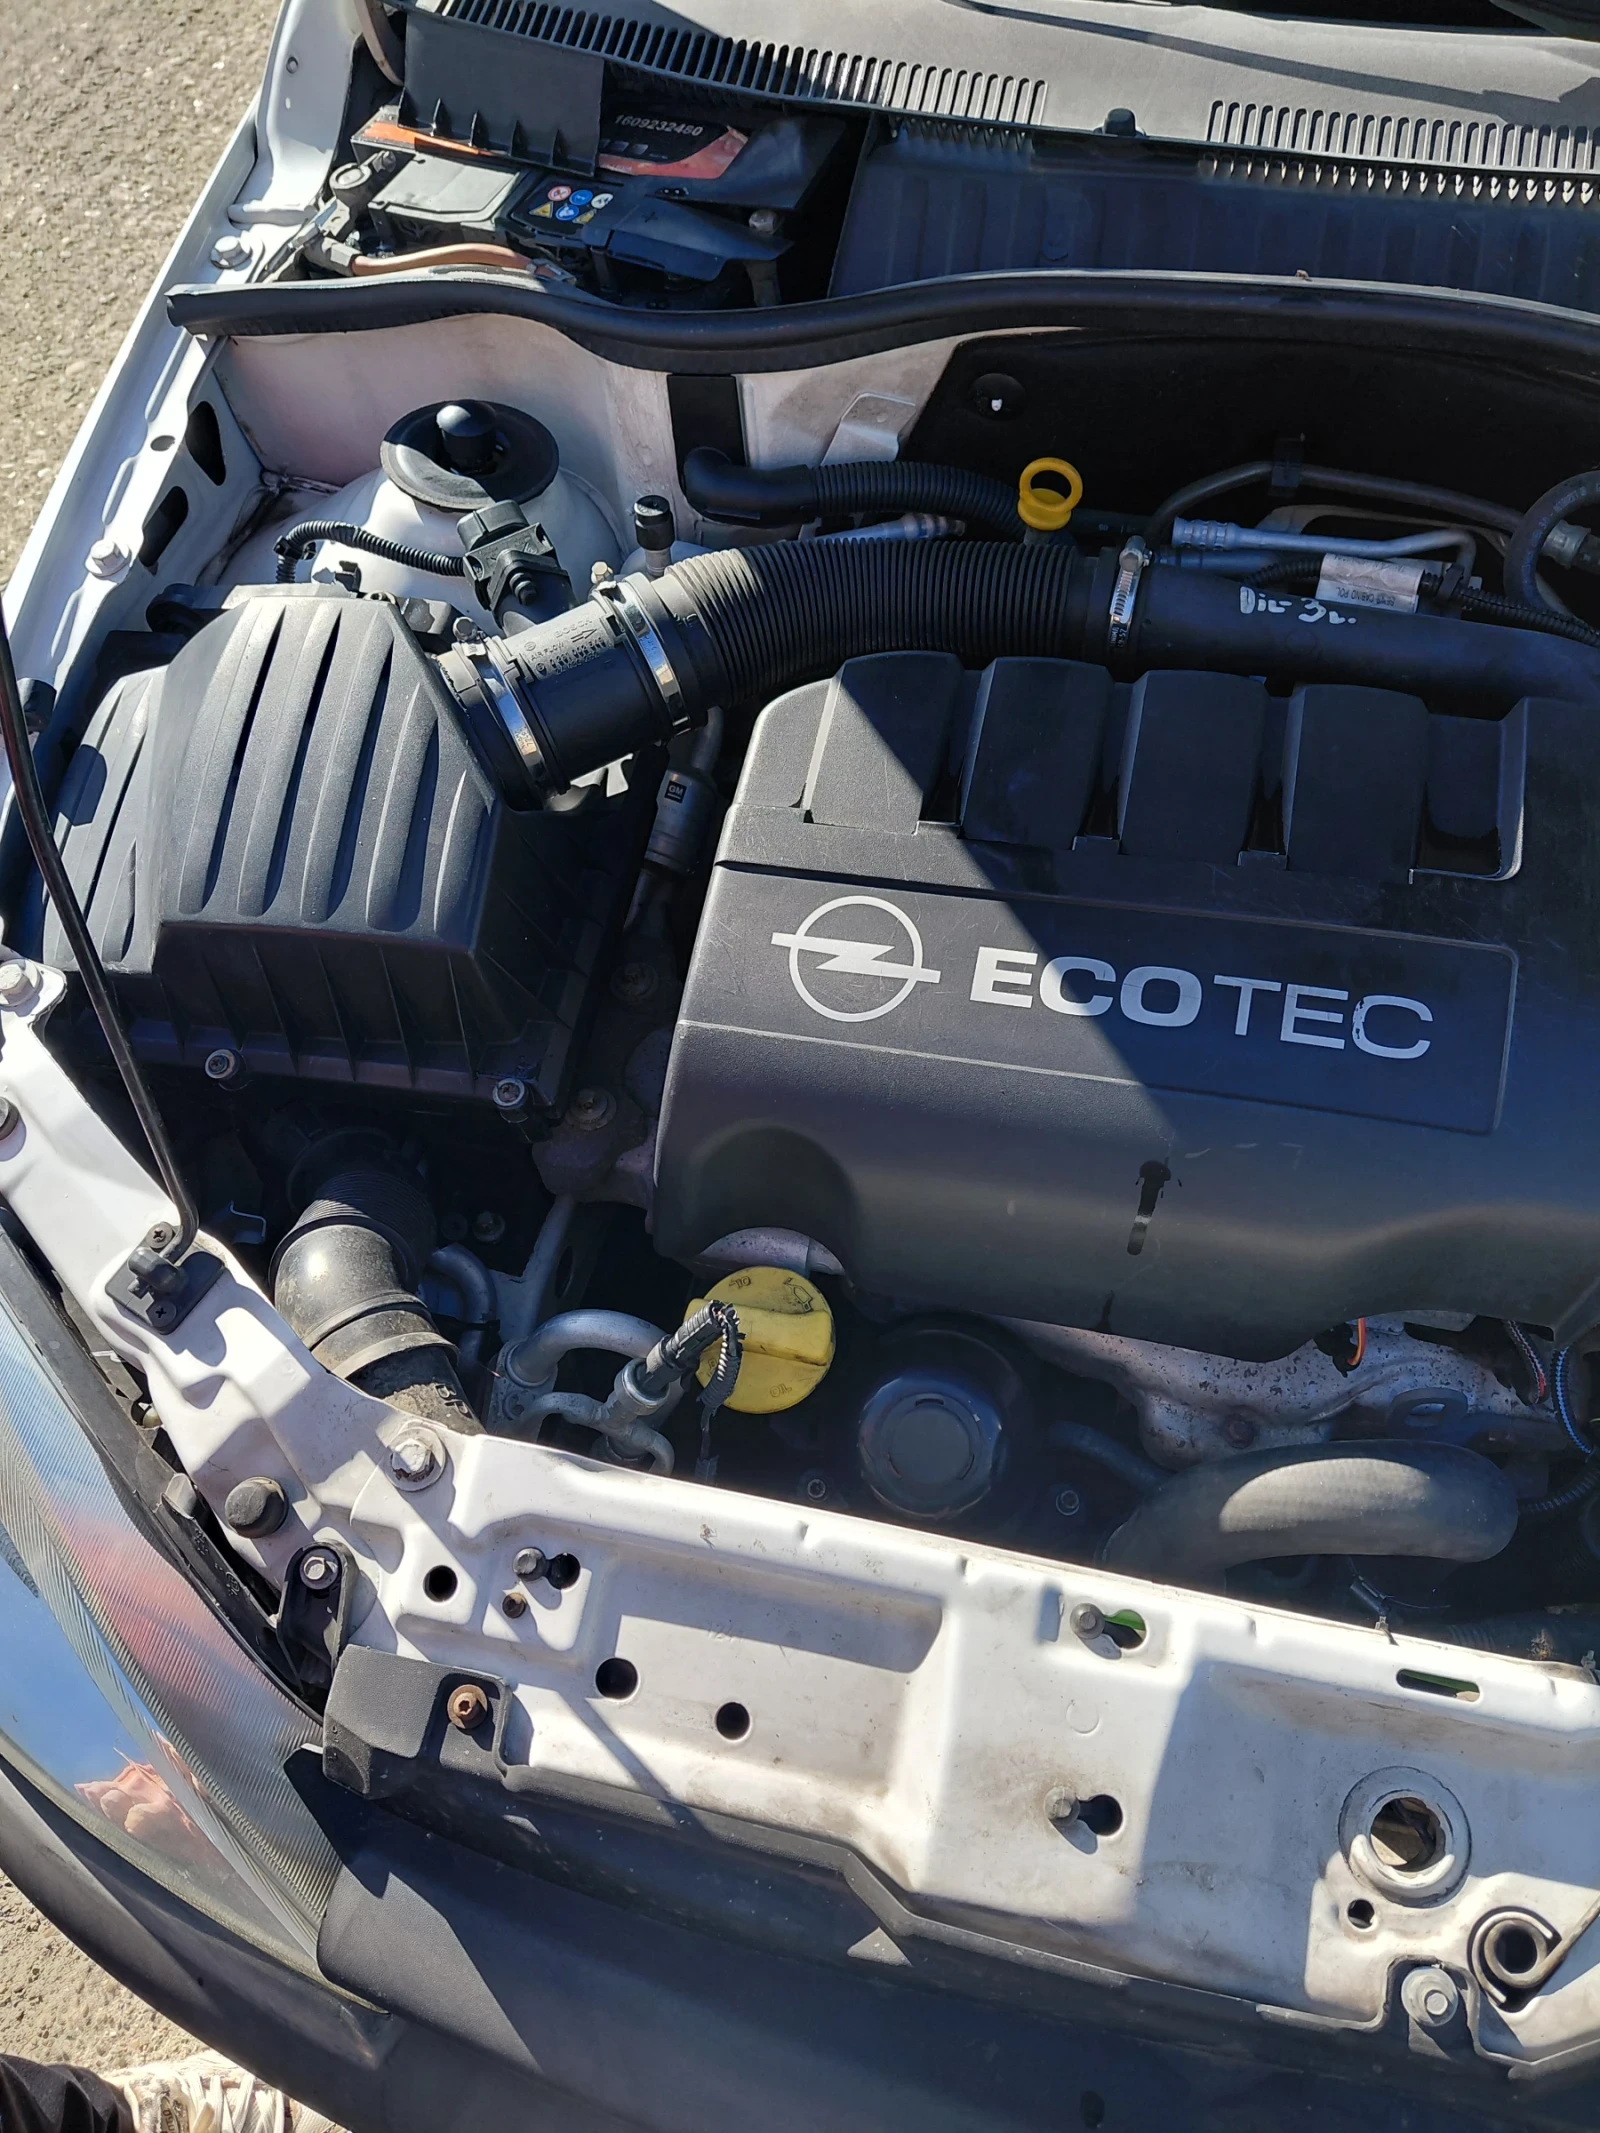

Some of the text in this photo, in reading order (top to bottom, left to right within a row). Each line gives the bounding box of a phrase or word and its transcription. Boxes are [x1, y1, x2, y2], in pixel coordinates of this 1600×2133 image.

[668, 784, 684, 796] GM
[969, 946, 1434, 1060] ECOTEC
[769, 1383, 793, 1398] OIL
